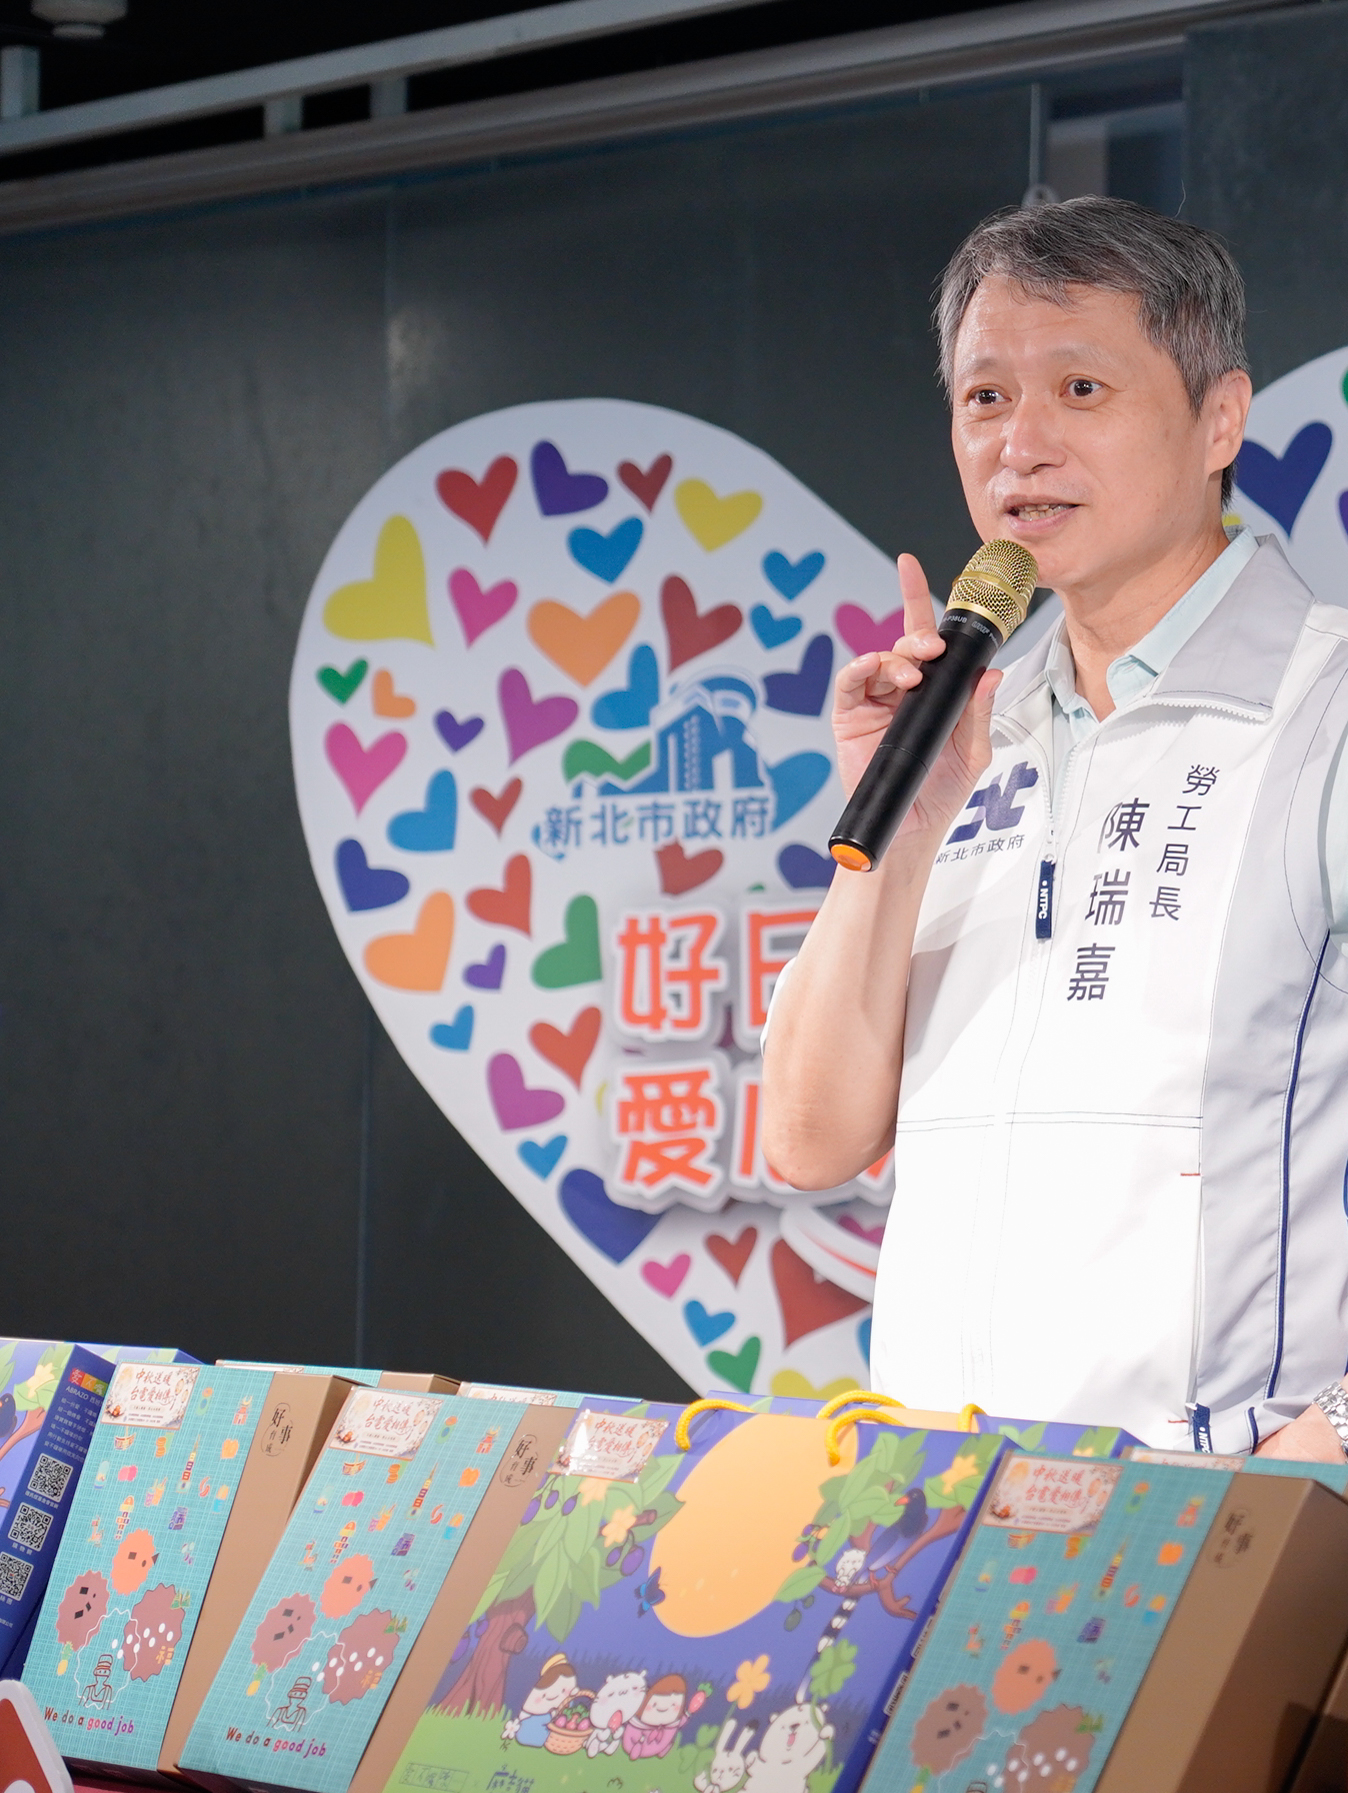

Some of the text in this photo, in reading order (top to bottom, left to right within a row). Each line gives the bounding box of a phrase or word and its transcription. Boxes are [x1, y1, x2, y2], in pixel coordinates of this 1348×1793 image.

[543, 797, 773, 848] 新北市政府
[936, 834, 1025, 865] 新北市政府
[1149, 764, 1220, 921] 勞工局長
[1038, 888, 1049, 920] NTPC
[1067, 797, 1150, 1001] 陳瑞嘉
[44, 1706, 134, 1736] We do a good job
[225, 1726, 326, 1758] We do a good job
